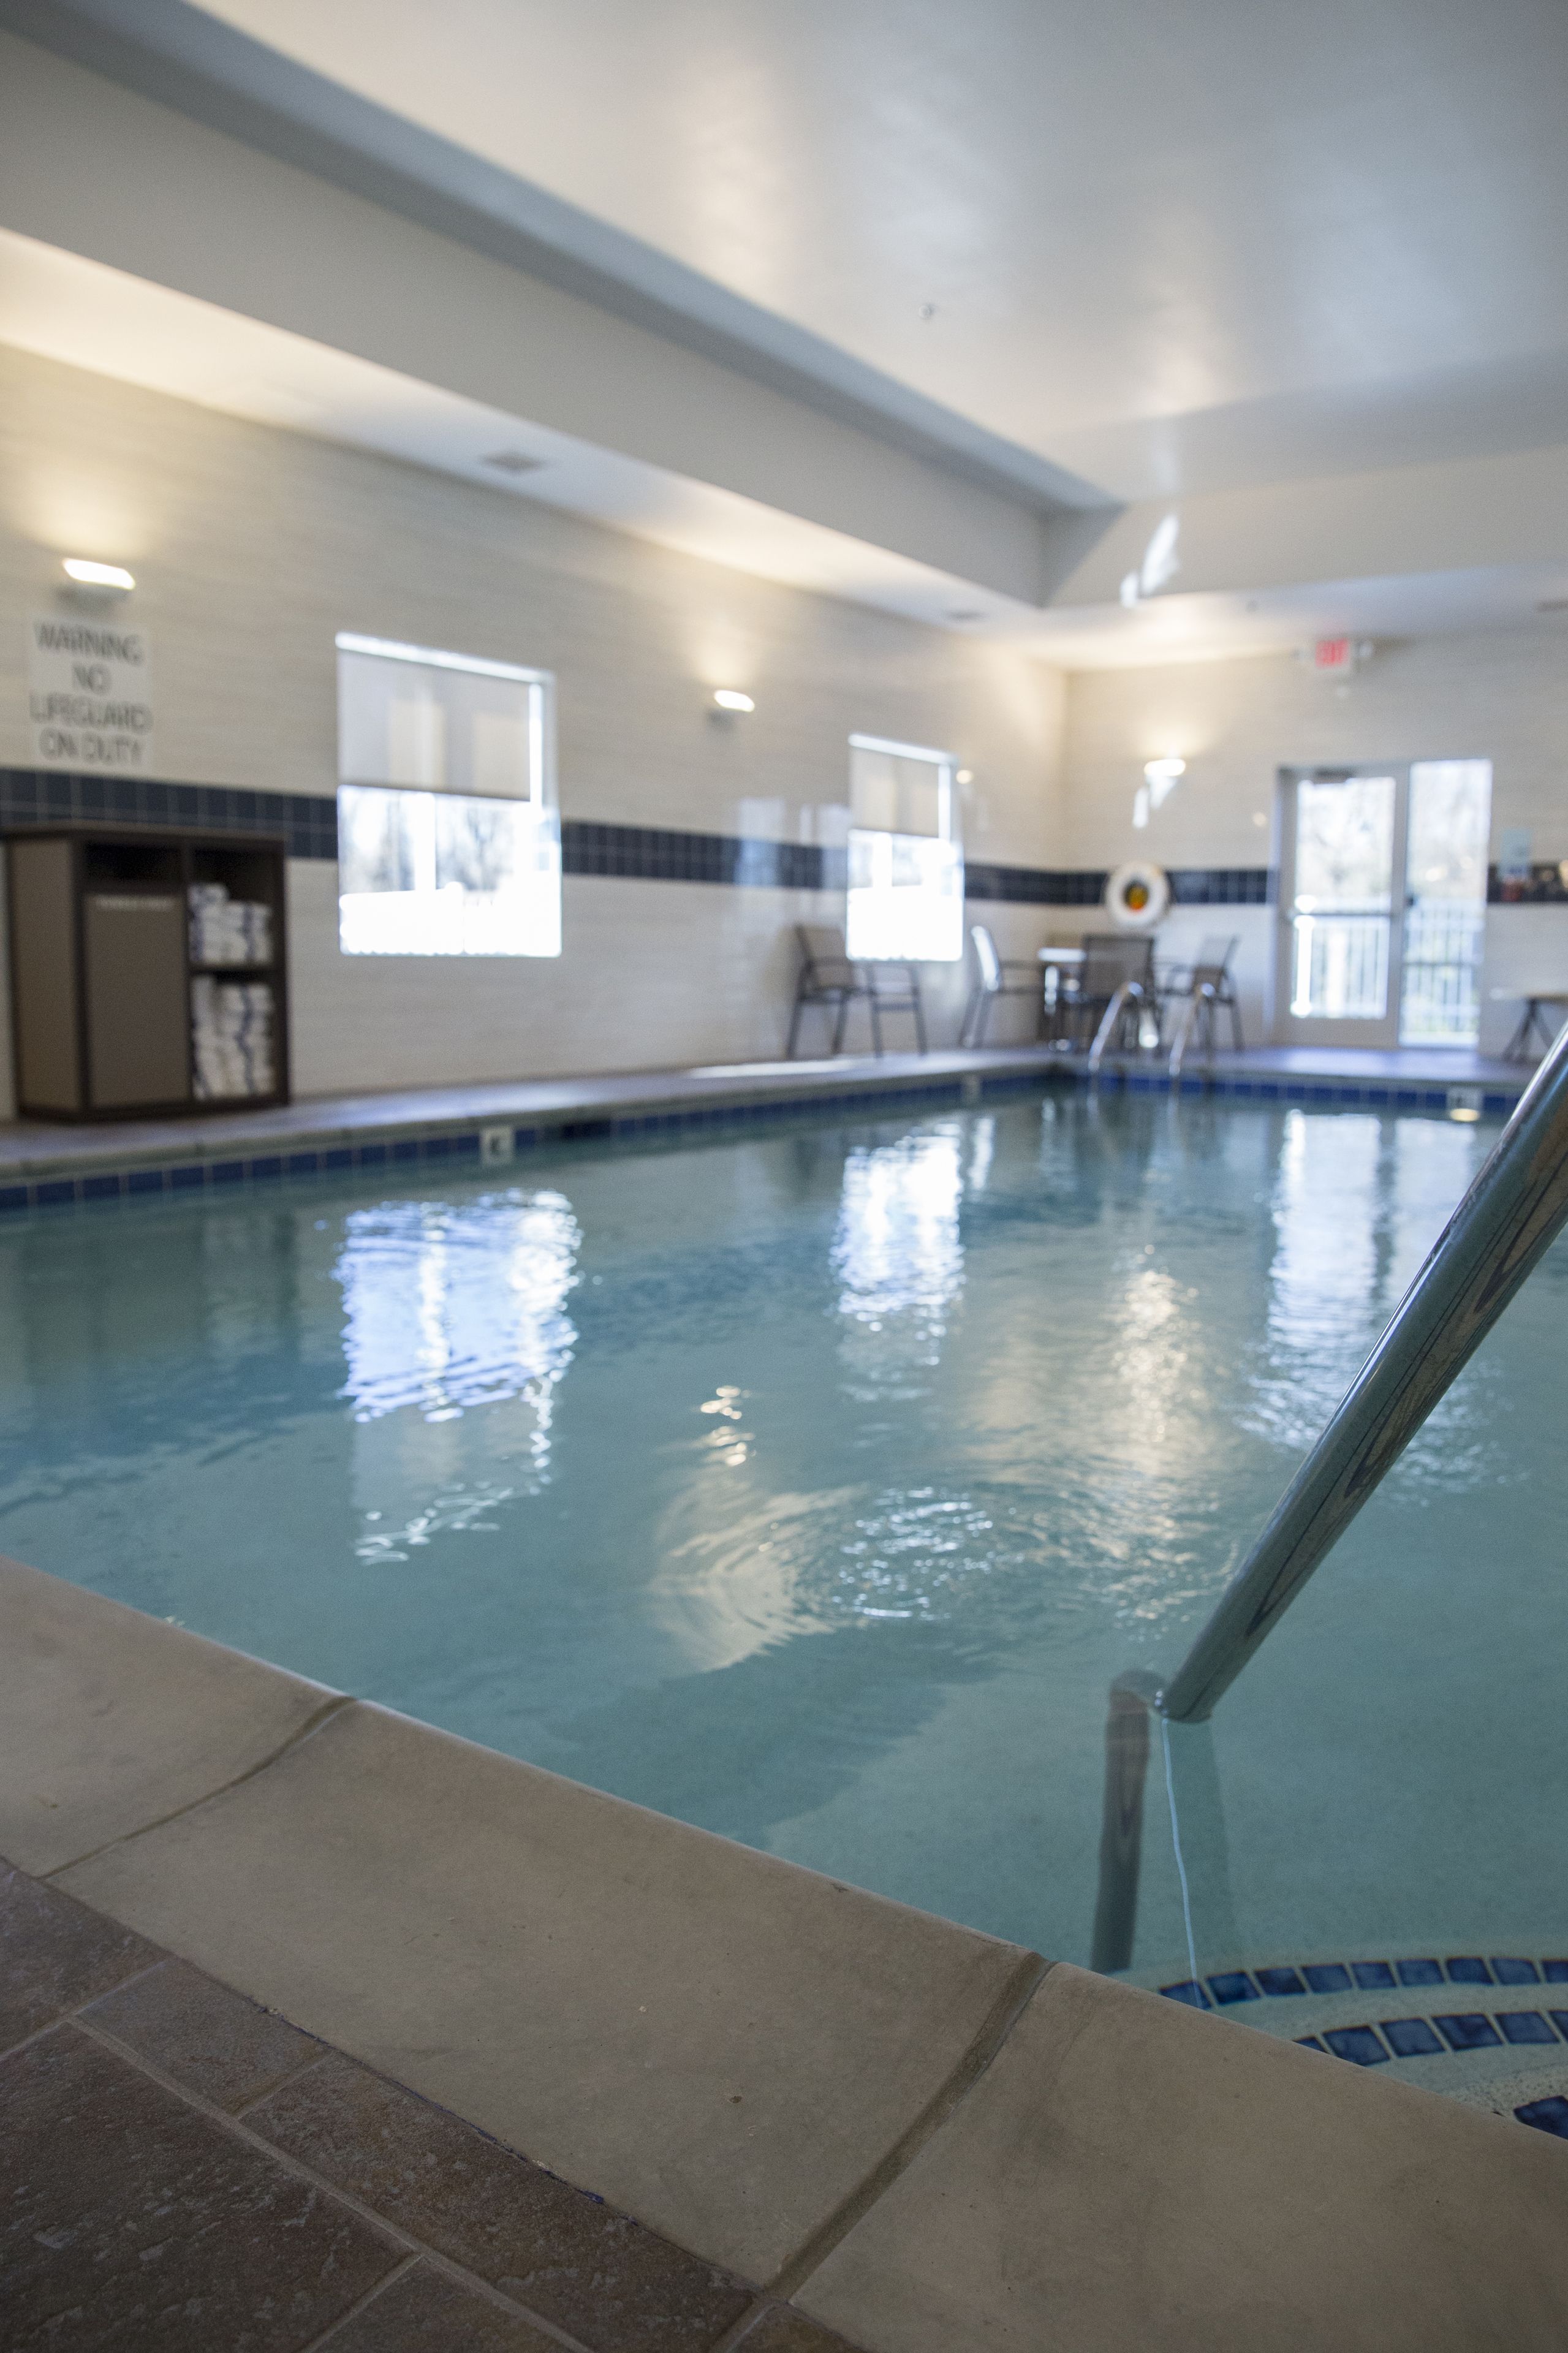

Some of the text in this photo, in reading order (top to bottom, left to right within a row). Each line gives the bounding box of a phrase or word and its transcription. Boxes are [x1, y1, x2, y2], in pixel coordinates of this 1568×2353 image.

[38, 623, 142, 664] WARNING
[74, 664, 111, 694] NO
[30, 693, 153, 733] LIFEGUARD
[40, 727, 142, 765] ON DUTY
